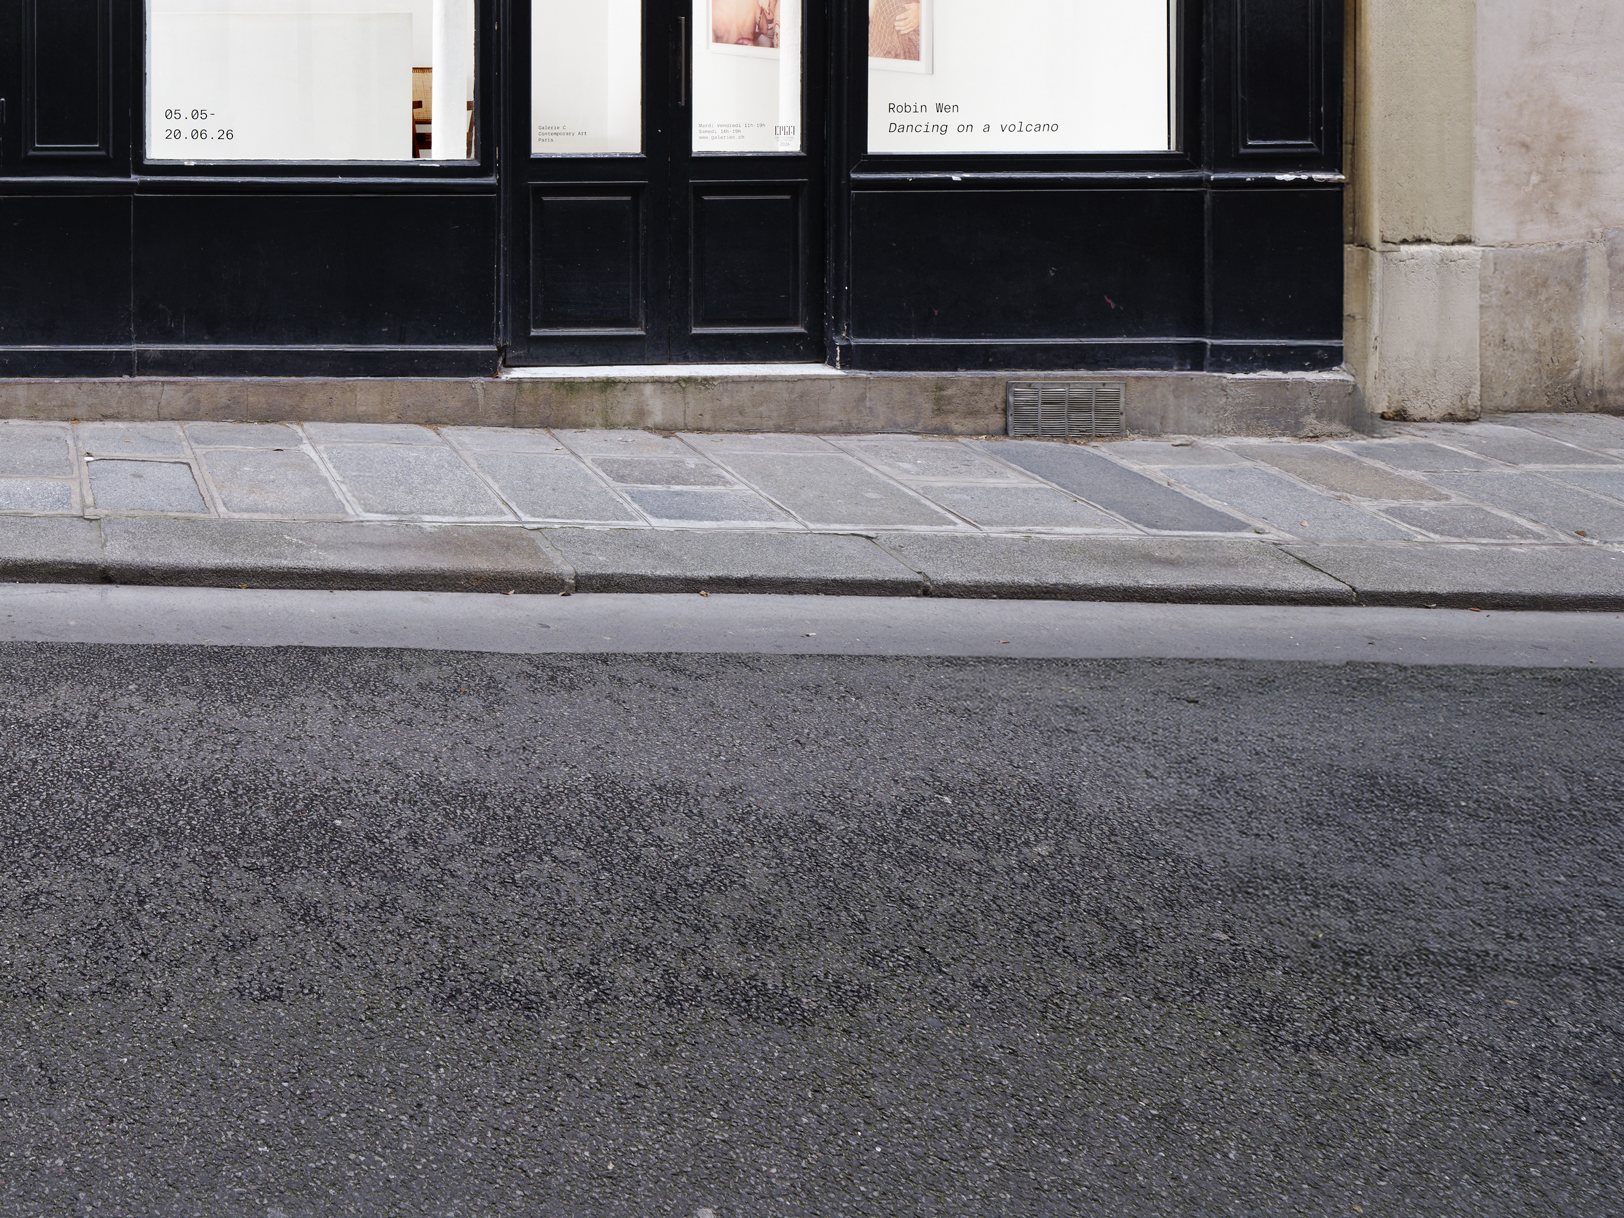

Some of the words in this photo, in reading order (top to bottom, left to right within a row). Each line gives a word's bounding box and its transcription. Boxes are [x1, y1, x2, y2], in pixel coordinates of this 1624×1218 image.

[889, 102, 927, 113] Robin
[936, 103, 958, 113] Wen
[165, 109, 215, 120] 05.05-
[889, 122, 948, 135] Dancing
[957, 124, 973, 132] on
[983, 124, 990, 132] a
[1001, 121, 1058, 132] volcano
[165, 129, 233, 140] 20.06.26
